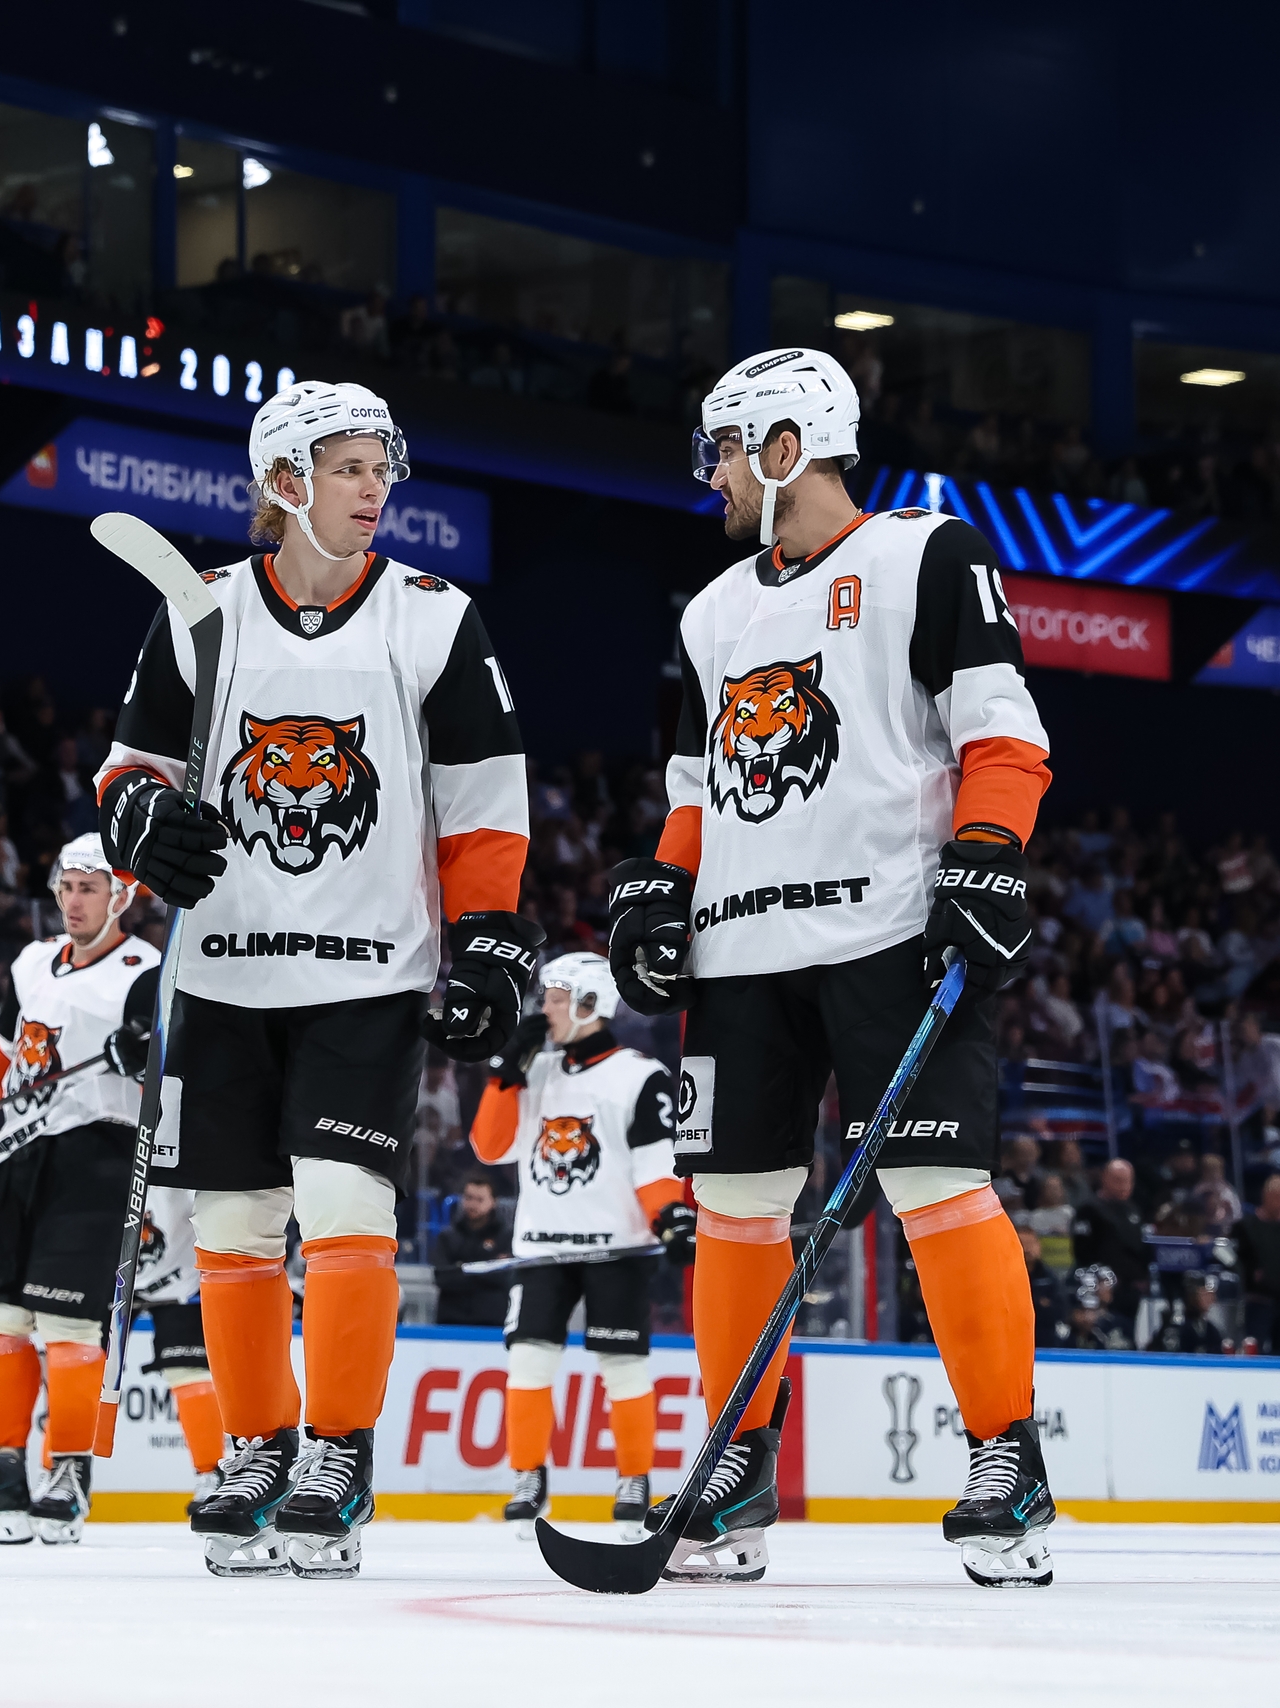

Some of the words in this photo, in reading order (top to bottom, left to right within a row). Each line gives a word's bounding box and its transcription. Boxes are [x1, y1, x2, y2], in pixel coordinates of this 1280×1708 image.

[747, 350, 801, 377] OLIMPBET
[263, 421, 289, 439] BAUER
[75, 446, 261, 515] ЧЕЛЯБИНС
[375, 505, 461, 549] АСТЬ
[826, 574, 862, 630] A
[1009, 603, 1151, 651] ТОГОРСК
[483, 655, 516, 713] 1
[110, 777, 171, 848] BAU
[608, 879, 676, 913] UER
[694, 876, 871, 934] OLIMPBET
[200, 932, 396, 965] OLIMPBET
[464, 935, 538, 974] BAU
[314, 1116, 400, 1153] BAUER
[677, 1129, 710, 1141] PBET
[845, 1119, 961, 1140] BUER
[131, 1124, 153, 1214] BAUER
[403, 1368, 705, 1470] FONBE
